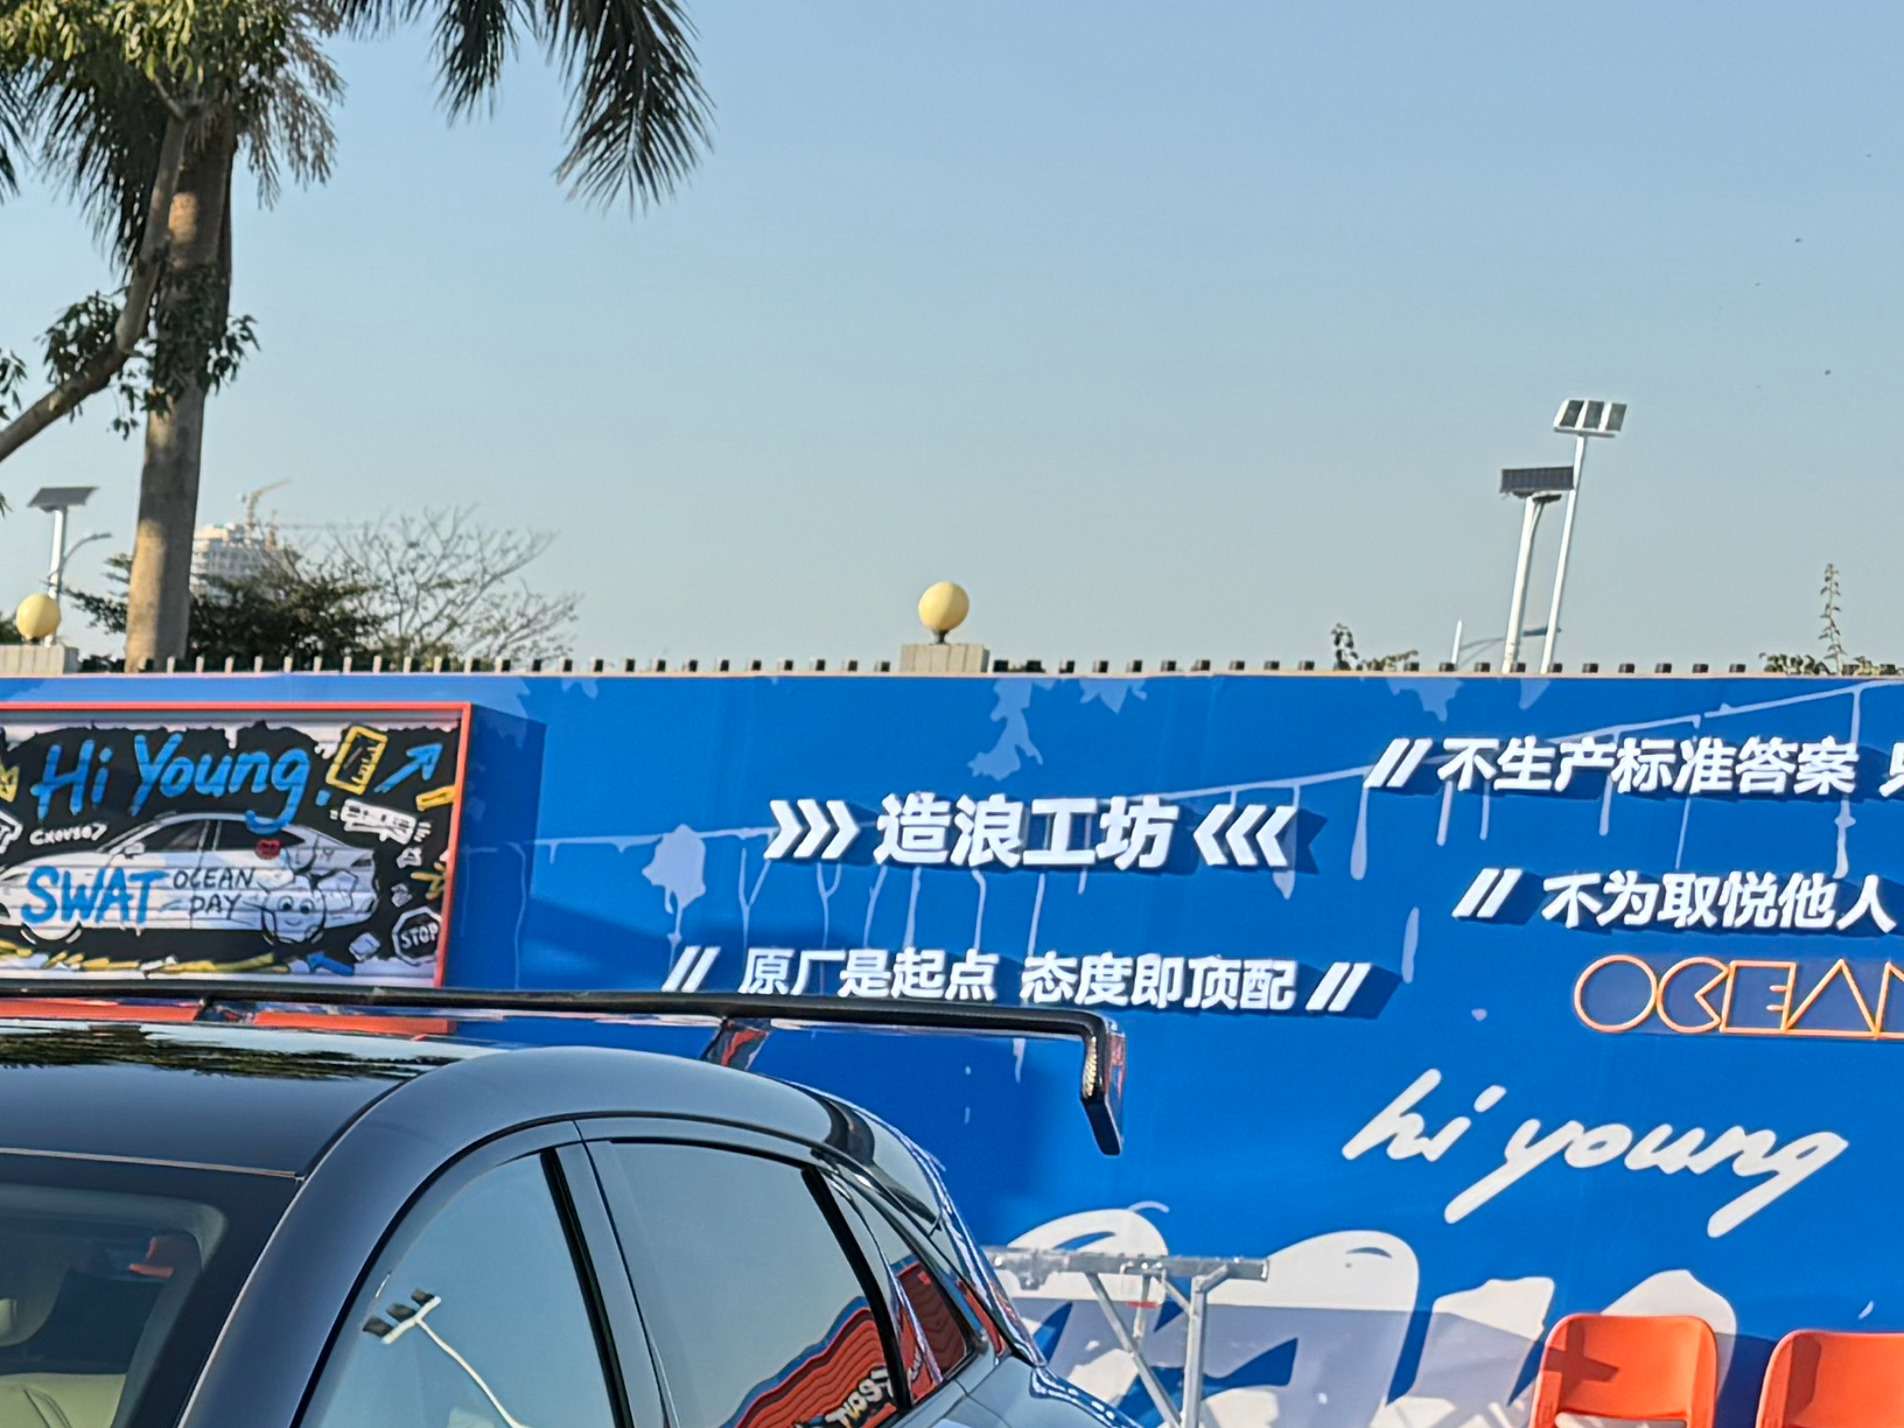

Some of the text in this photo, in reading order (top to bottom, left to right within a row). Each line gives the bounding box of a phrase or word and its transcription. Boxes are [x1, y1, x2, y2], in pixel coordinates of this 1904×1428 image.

[31, 739, 112, 821] Hi
[1437, 735, 1860, 795] 不生产标准答案
[874, 791, 1181, 872] 造浪工坊
[21, 865, 172, 925] SWAT
[189, 893, 242, 920] DAY
[1542, 870, 1896, 933] 不为取悦他人
[401, 922, 440, 948] STOP
[738, 946, 1299, 1011] 原厂是起点 态度即顶配
[1443, 1115, 1850, 1238] young
